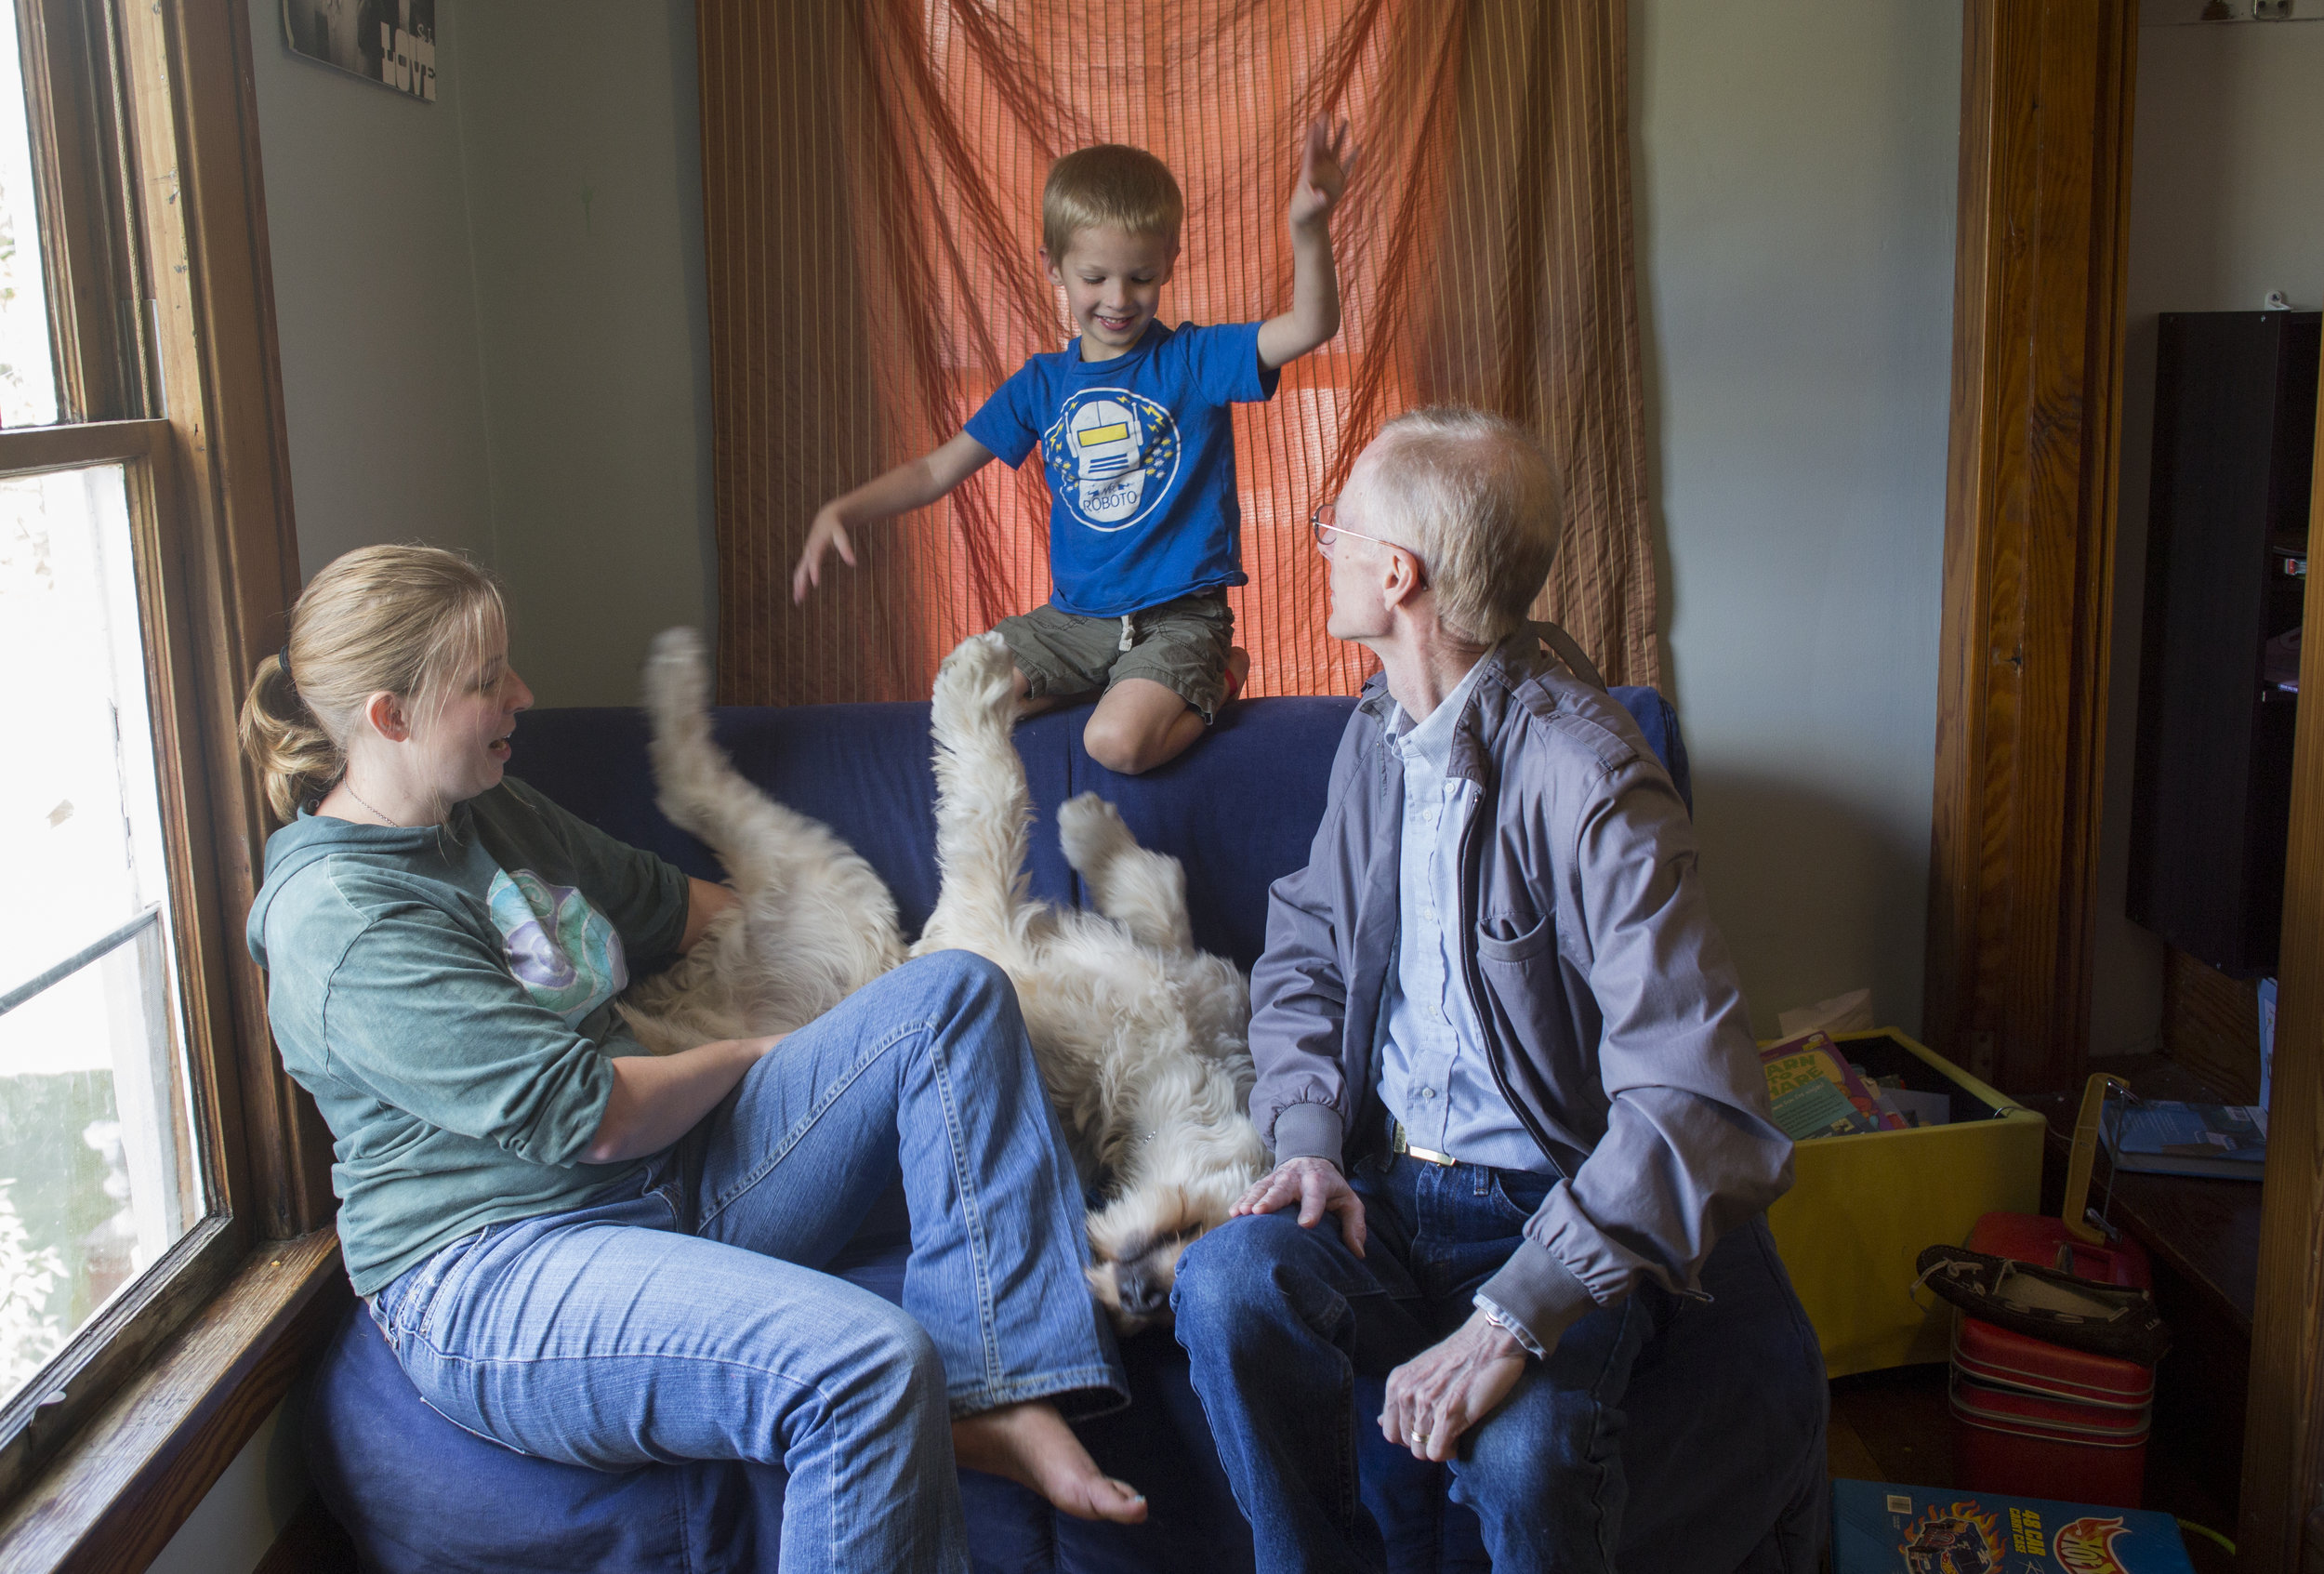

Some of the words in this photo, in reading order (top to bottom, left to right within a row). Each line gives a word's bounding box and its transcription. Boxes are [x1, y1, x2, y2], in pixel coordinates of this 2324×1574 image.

[1083, 490, 1137, 511] ROBOTO
[1768, 1073, 1792, 1084] TO
[2008, 1507, 2024, 1534] CARRY
[2022, 1509, 2041, 1529] 48
[2013, 1533, 2027, 1554] CASE
[2025, 1529, 2046, 1556] CAR
